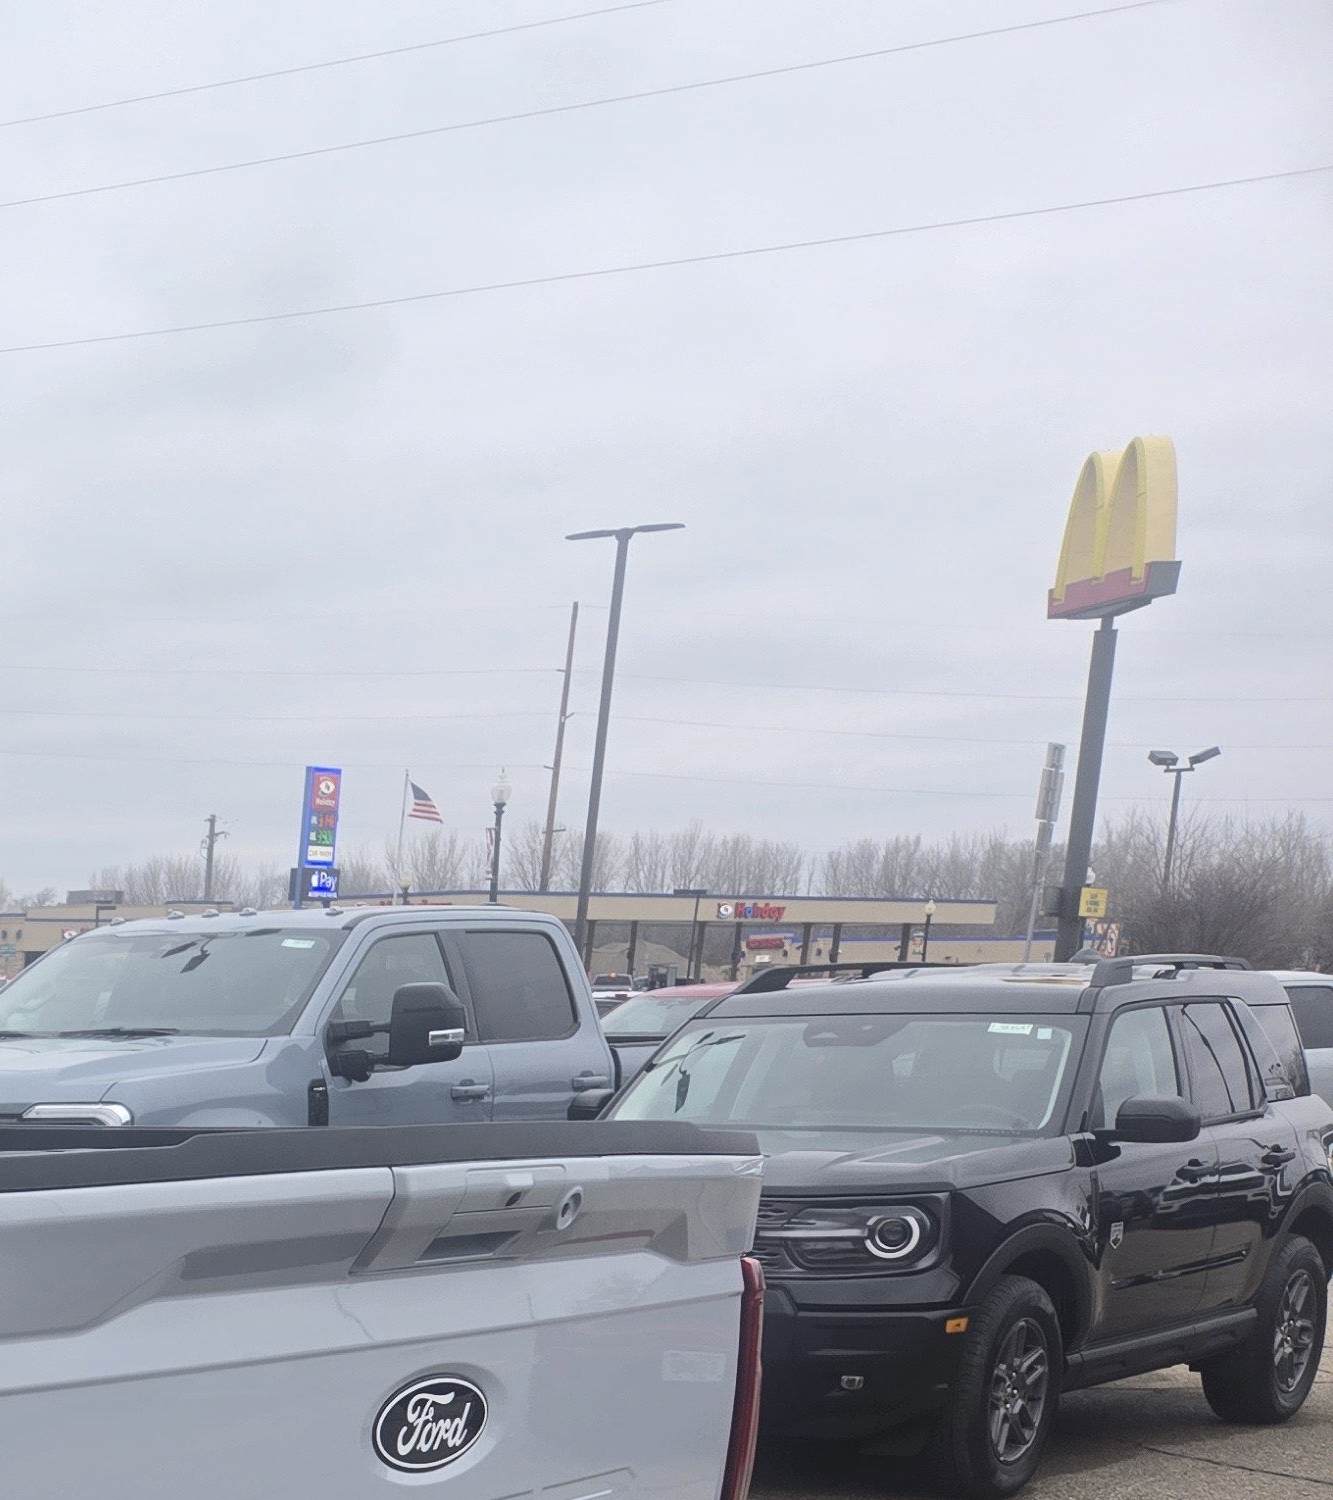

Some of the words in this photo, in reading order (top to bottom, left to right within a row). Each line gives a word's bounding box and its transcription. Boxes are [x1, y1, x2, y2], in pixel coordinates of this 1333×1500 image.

[319, 872, 338, 892] Pay
[734, 902, 786, 922] Holiday
[397, 1391, 469, 1456] Ford
